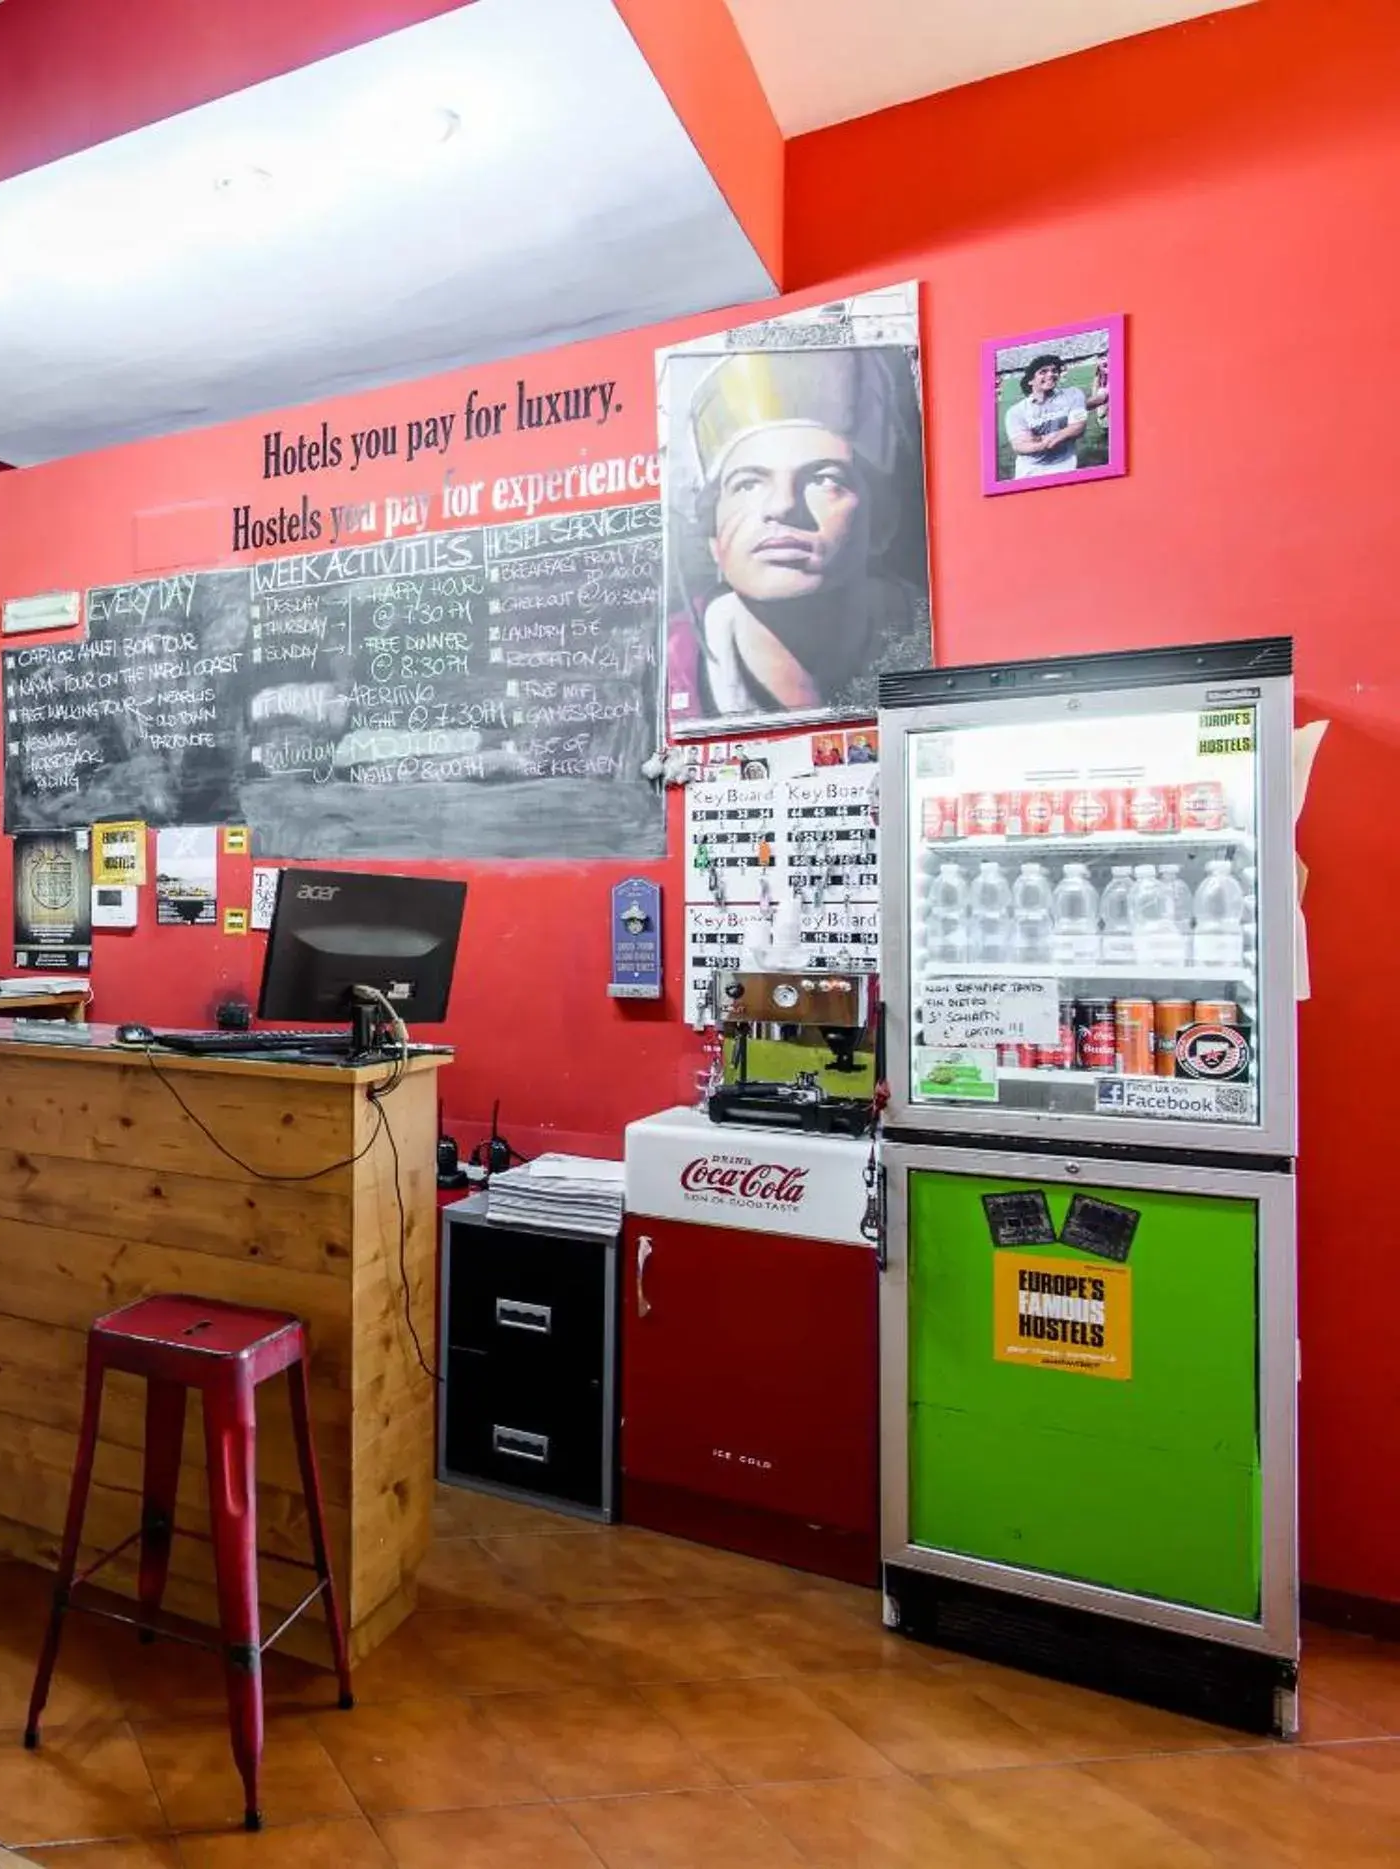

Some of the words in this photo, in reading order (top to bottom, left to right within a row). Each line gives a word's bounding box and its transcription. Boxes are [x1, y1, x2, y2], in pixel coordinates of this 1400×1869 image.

[262, 422, 342, 479] Hotels
[350, 430, 397, 470] you
[407, 412, 456, 462] pay
[465, 390, 506, 441] for
[516, 380, 623, 433] luxury.
[232, 495, 322, 552] Hostels
[331, 500, 375, 544] you
[385, 490, 431, 539] pay
[441, 467, 484, 520] for
[255, 555, 321, 591] WEEK
[323, 536, 473, 580] ACTIVITIES
[431, 575, 484, 597] HOUR
[264, 596, 320, 614] TUESDAY
[405, 631, 474, 652] DINNER
[501, 622, 565, 647] LAUNDRY
[265, 643, 318, 668] SUNDAY
[63, 671, 96, 693] TOUR
[1200, 737, 1251, 754] HOSTELS
[297, 884, 341, 900] acer
[1126, 1093, 1214, 1112] Facebook
[711, 1154, 753, 1167] DRINK
[680, 1157, 811, 1204] Coca-Cola
[1018, 1268, 1105, 1302] EUROPE'S
[1018, 1289, 1105, 1325] FAMOUS
[1018, 1313, 1105, 1349] HOSTELS
[712, 1448, 732, 1460] ICE
[738, 1455, 772, 1468] COLD
